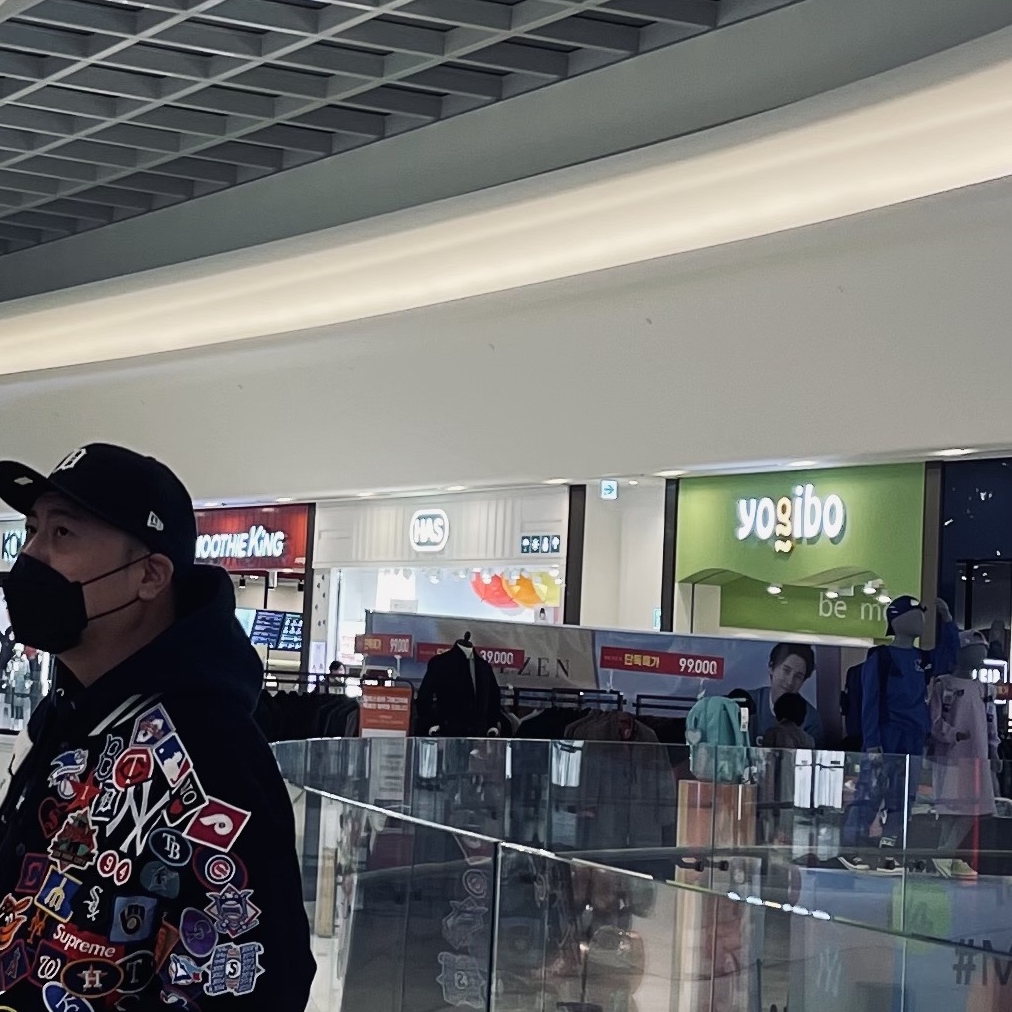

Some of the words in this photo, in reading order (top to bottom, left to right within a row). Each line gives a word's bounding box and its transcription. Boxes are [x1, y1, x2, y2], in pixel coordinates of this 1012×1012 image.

[736, 483, 845, 553] yogibo
[819, 592, 847, 618] be
[162, 832, 181, 860] TB
[52, 922, 116, 958] Supreme
[38, 955, 61, 980] W
[81, 968, 103, 990] H
